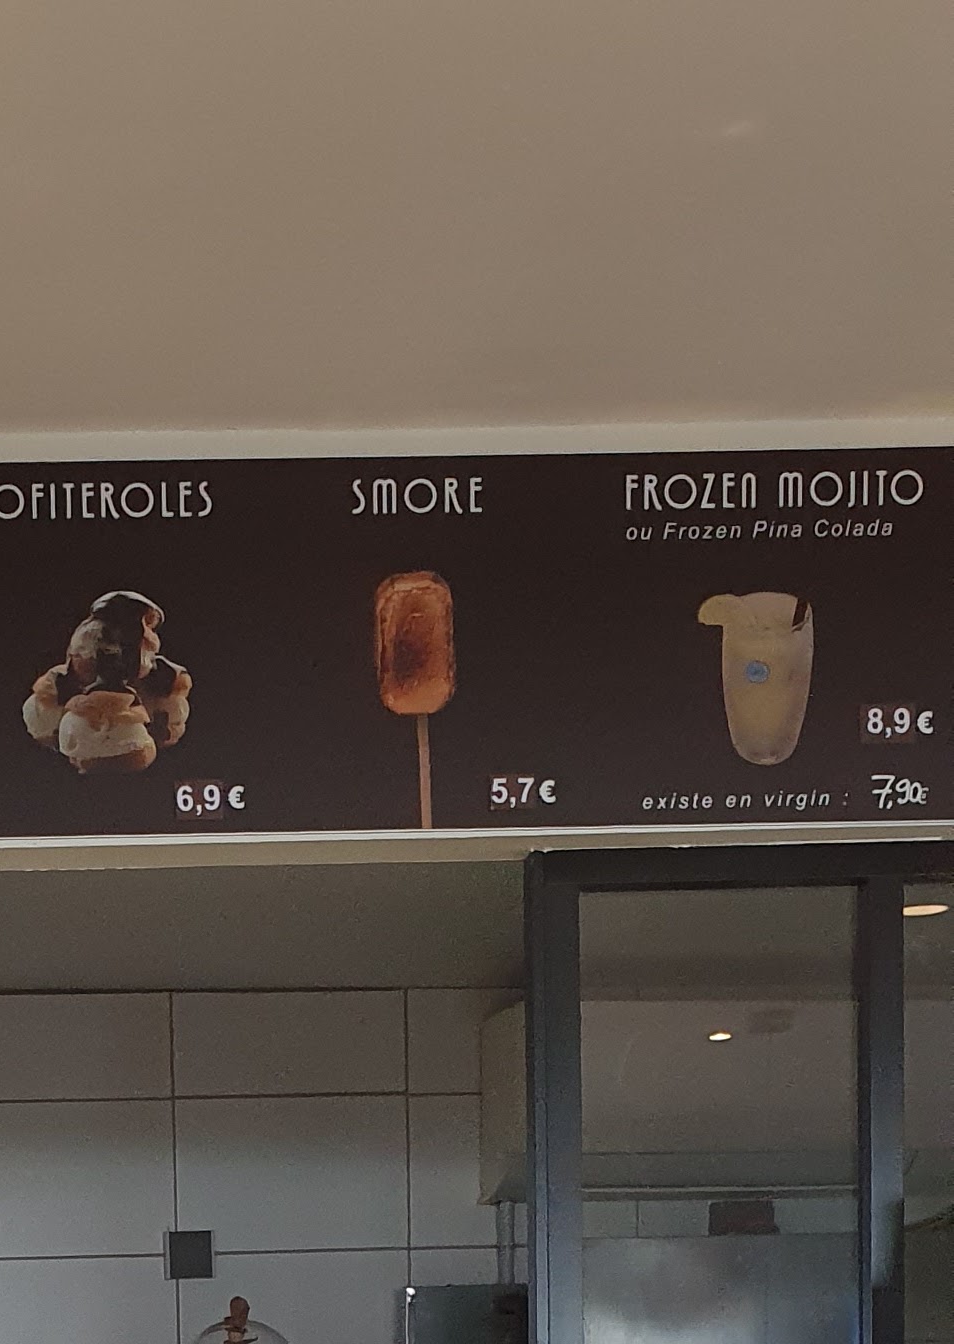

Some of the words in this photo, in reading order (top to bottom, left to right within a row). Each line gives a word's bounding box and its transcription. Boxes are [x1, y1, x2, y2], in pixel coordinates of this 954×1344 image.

[351, 477, 483, 515] SMORE
[625, 472, 757, 511] FROZEN
[778, 469, 924, 508] MOJITO
[626, 526, 652, 541] ou
[663, 522, 741, 540] Frozen
[752, 520, 802, 538] Pina
[814, 519, 893, 537] Colada
[642, 792, 713, 810] existe
[725, 794, 752, 808] en
[764, 789, 830, 811] virgin
